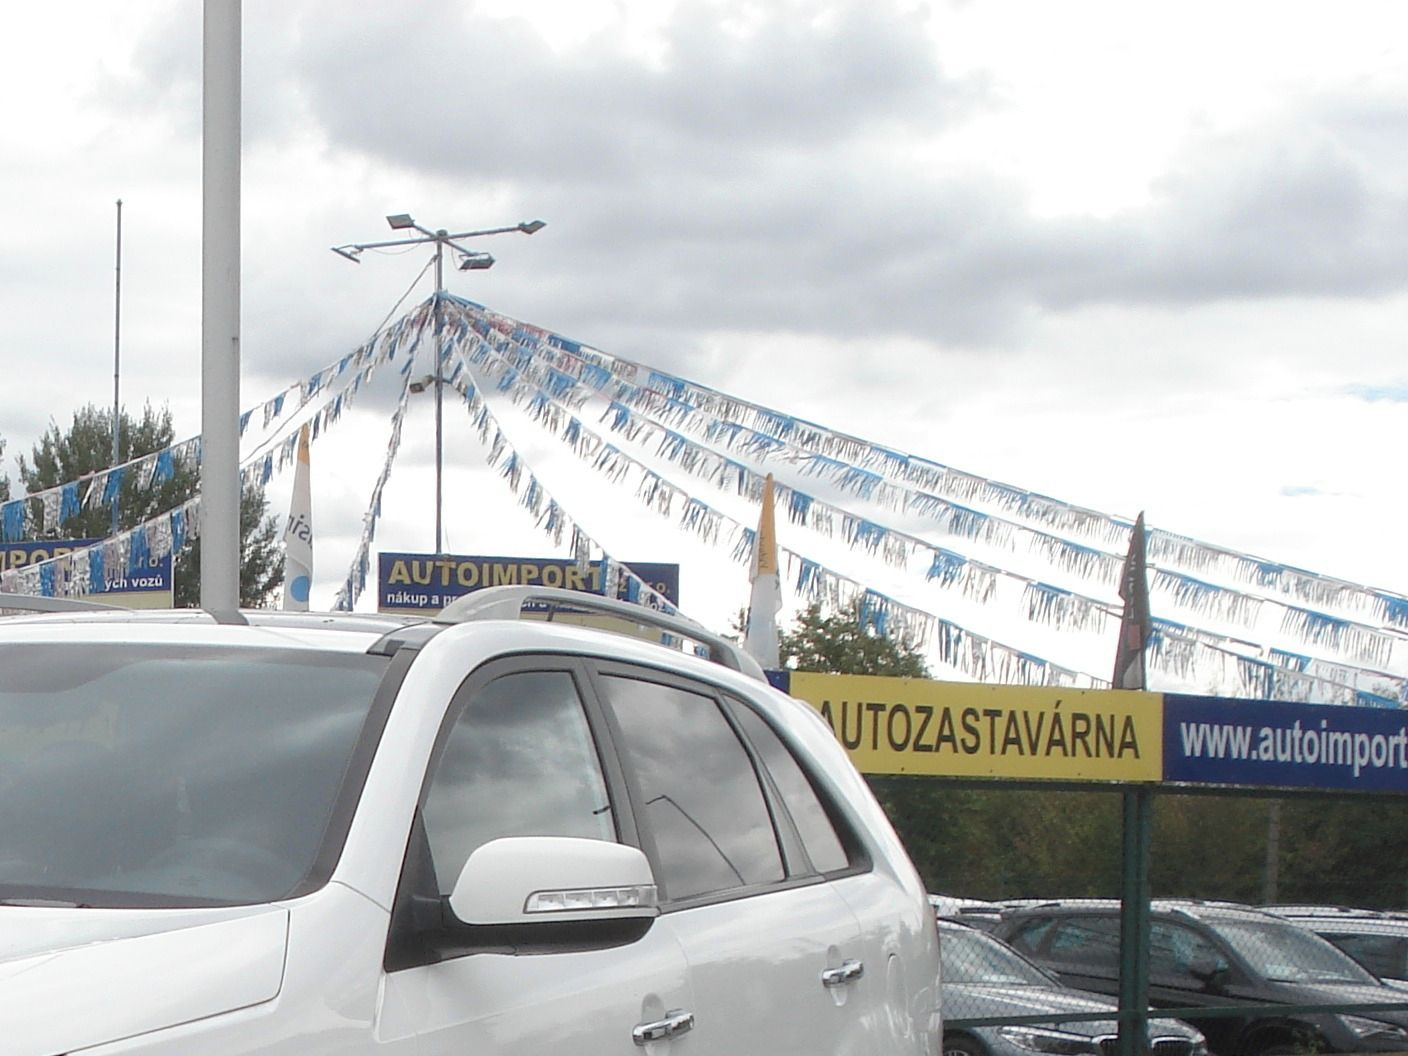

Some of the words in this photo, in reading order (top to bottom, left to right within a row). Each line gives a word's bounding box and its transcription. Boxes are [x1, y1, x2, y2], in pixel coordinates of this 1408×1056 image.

[131, 574, 163, 587] vozů
[388, 559, 602, 592] AUTOIMPORT
[387, 591, 428, 606] nákup
[431, 595, 440, 604] a
[821, 700, 1141, 760] AUTOZASTAVÁRNA
[1180, 718, 1408, 778] www.autoimport
